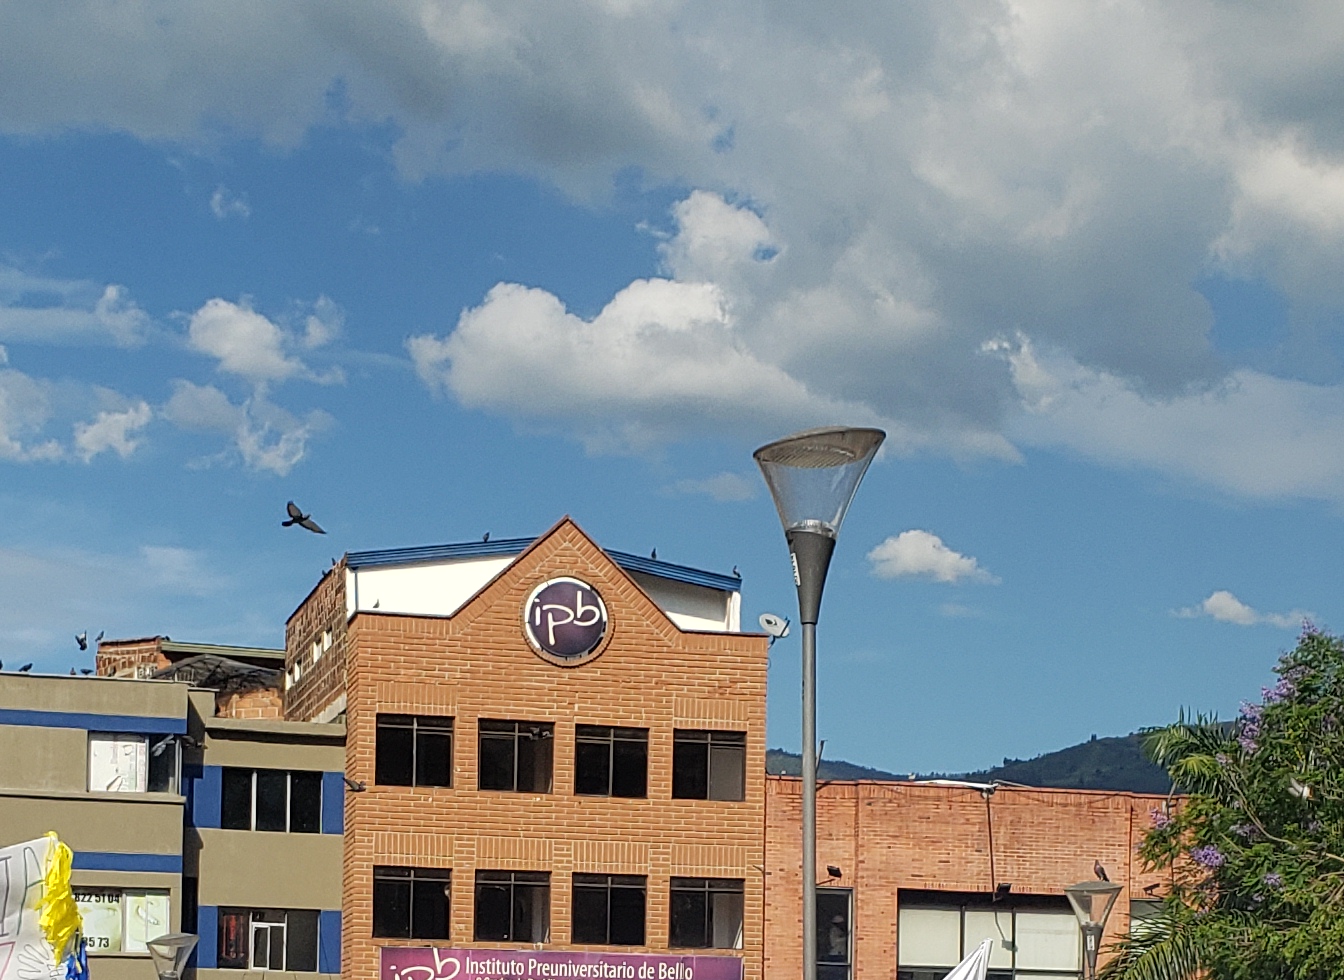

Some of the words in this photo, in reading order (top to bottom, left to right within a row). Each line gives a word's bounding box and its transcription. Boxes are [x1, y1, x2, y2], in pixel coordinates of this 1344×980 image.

[534, 590, 600, 646] ipb
[466, 956, 524, 976] Instituto
[528, 958, 635, 979] Preuniversitario
[638, 962, 655, 979] de
[658, 962, 693, 980] Bello
